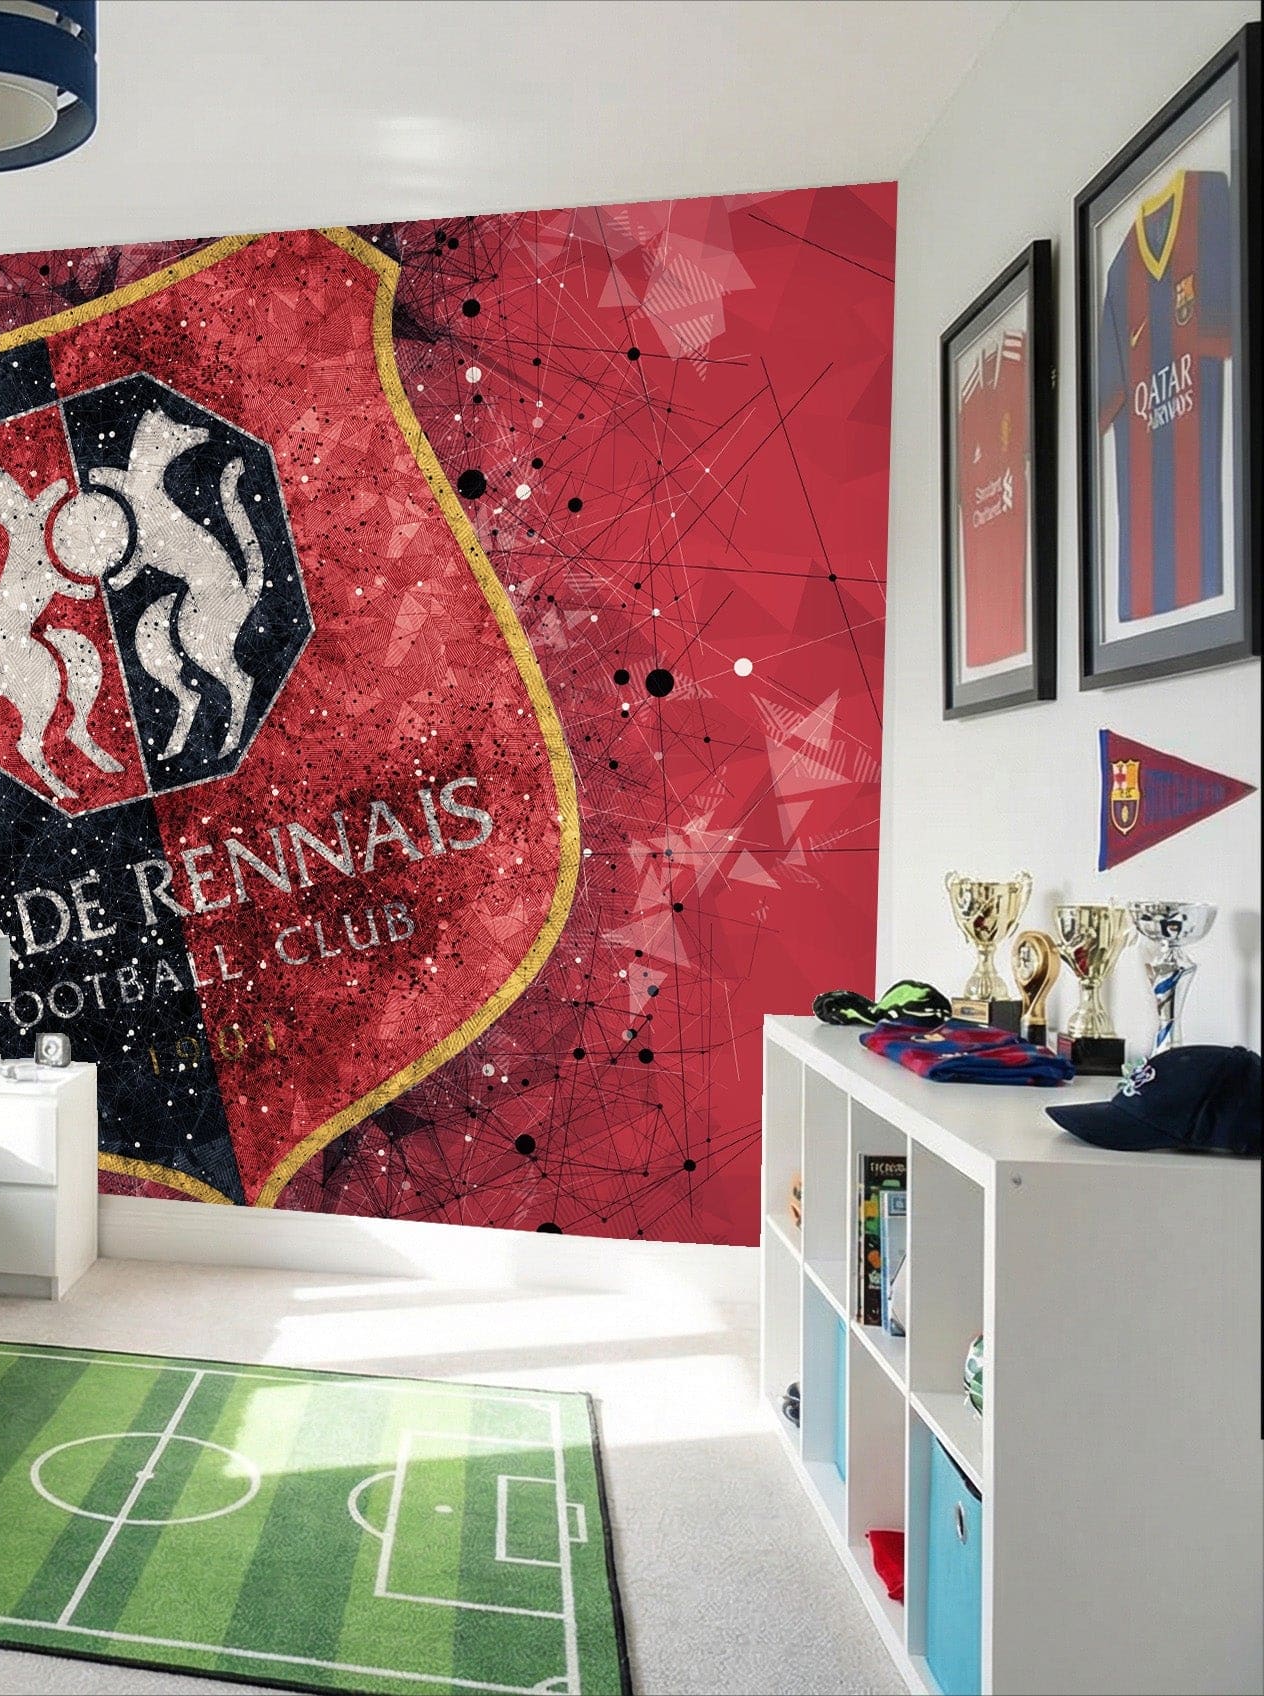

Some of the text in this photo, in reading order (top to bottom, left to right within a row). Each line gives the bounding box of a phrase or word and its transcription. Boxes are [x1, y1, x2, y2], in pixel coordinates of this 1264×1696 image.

[1134, 352, 1193, 421] QATAR
[131, 776, 494, 926] RENNAIS
[274, 901, 416, 966] CLUB
[148, 1019, 277, 1078] 1901
